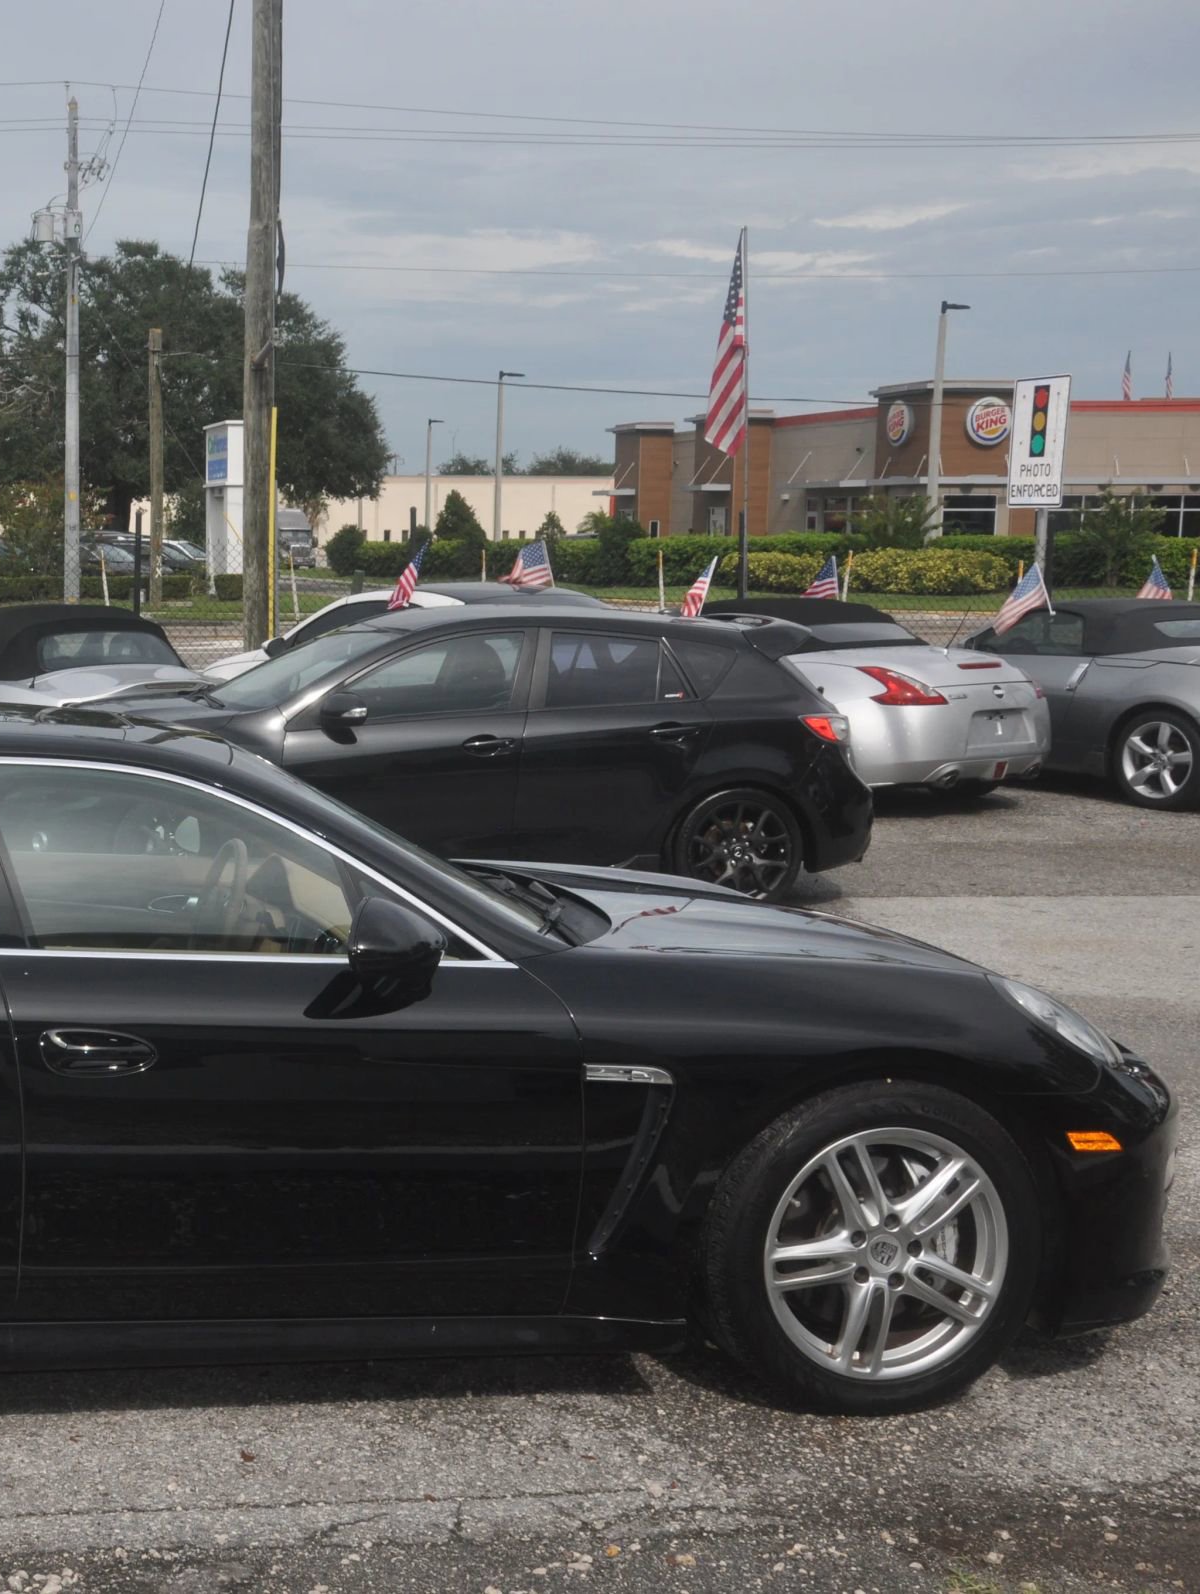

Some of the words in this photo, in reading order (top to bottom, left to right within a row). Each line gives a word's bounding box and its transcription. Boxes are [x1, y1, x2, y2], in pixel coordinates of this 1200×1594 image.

[975, 407, 1005, 422] BURGER
[976, 414, 1006, 432] KING
[1019, 463, 1051, 477] PHOTO
[1011, 483, 1058, 498] ENFORCED
